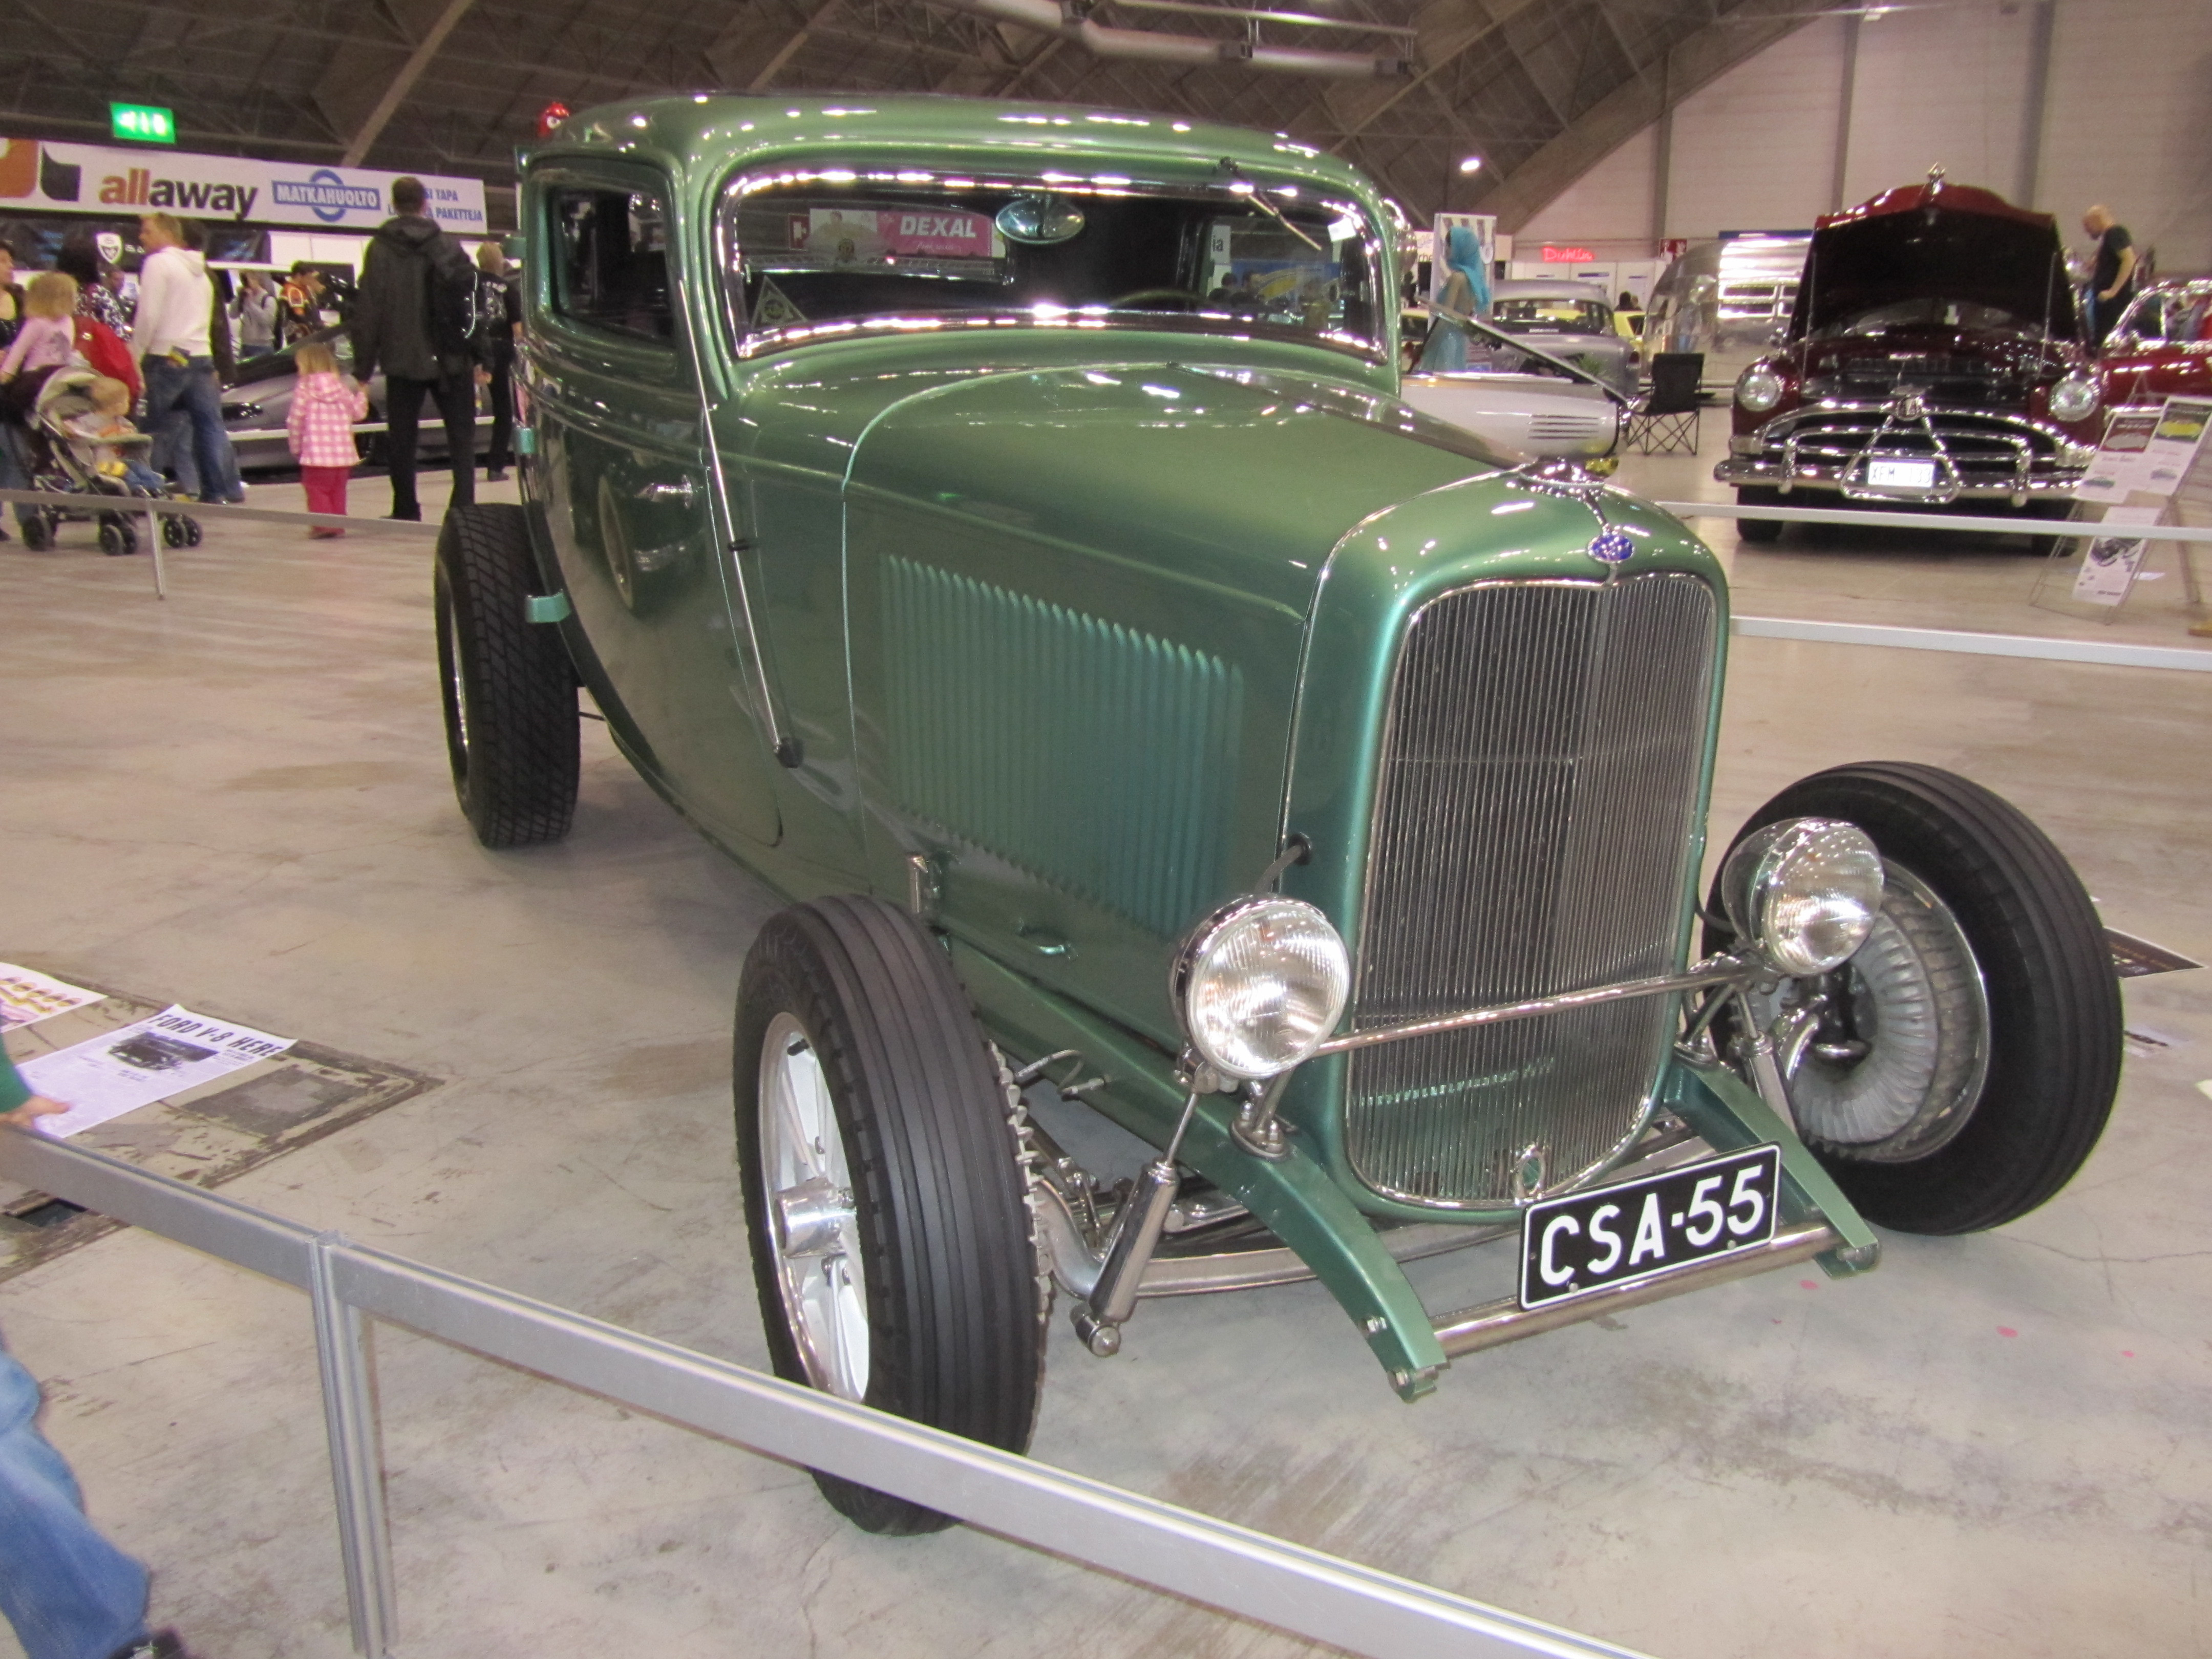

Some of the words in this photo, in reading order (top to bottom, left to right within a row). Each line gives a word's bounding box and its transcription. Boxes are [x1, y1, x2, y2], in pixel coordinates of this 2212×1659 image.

[98, 167, 258, 220] allaway
[276, 184, 377, 207] MATKAHUOLTO
[435, 188, 458, 201] TAPA
[436, 206, 483, 221] PAKETTEJA
[900, 215, 977, 238] DEXAL
[1543, 246, 1593, 262] Dublin
[1870, 466, 1896, 481] XFM
[1908, 467, 1931, 483] 133
[148, 1014, 203, 1033] FORD
[195, 1027, 235, 1043] V-8
[226, 1036, 284, 1056] HERE
[1540, 1164, 1765, 1286] CSA-55
